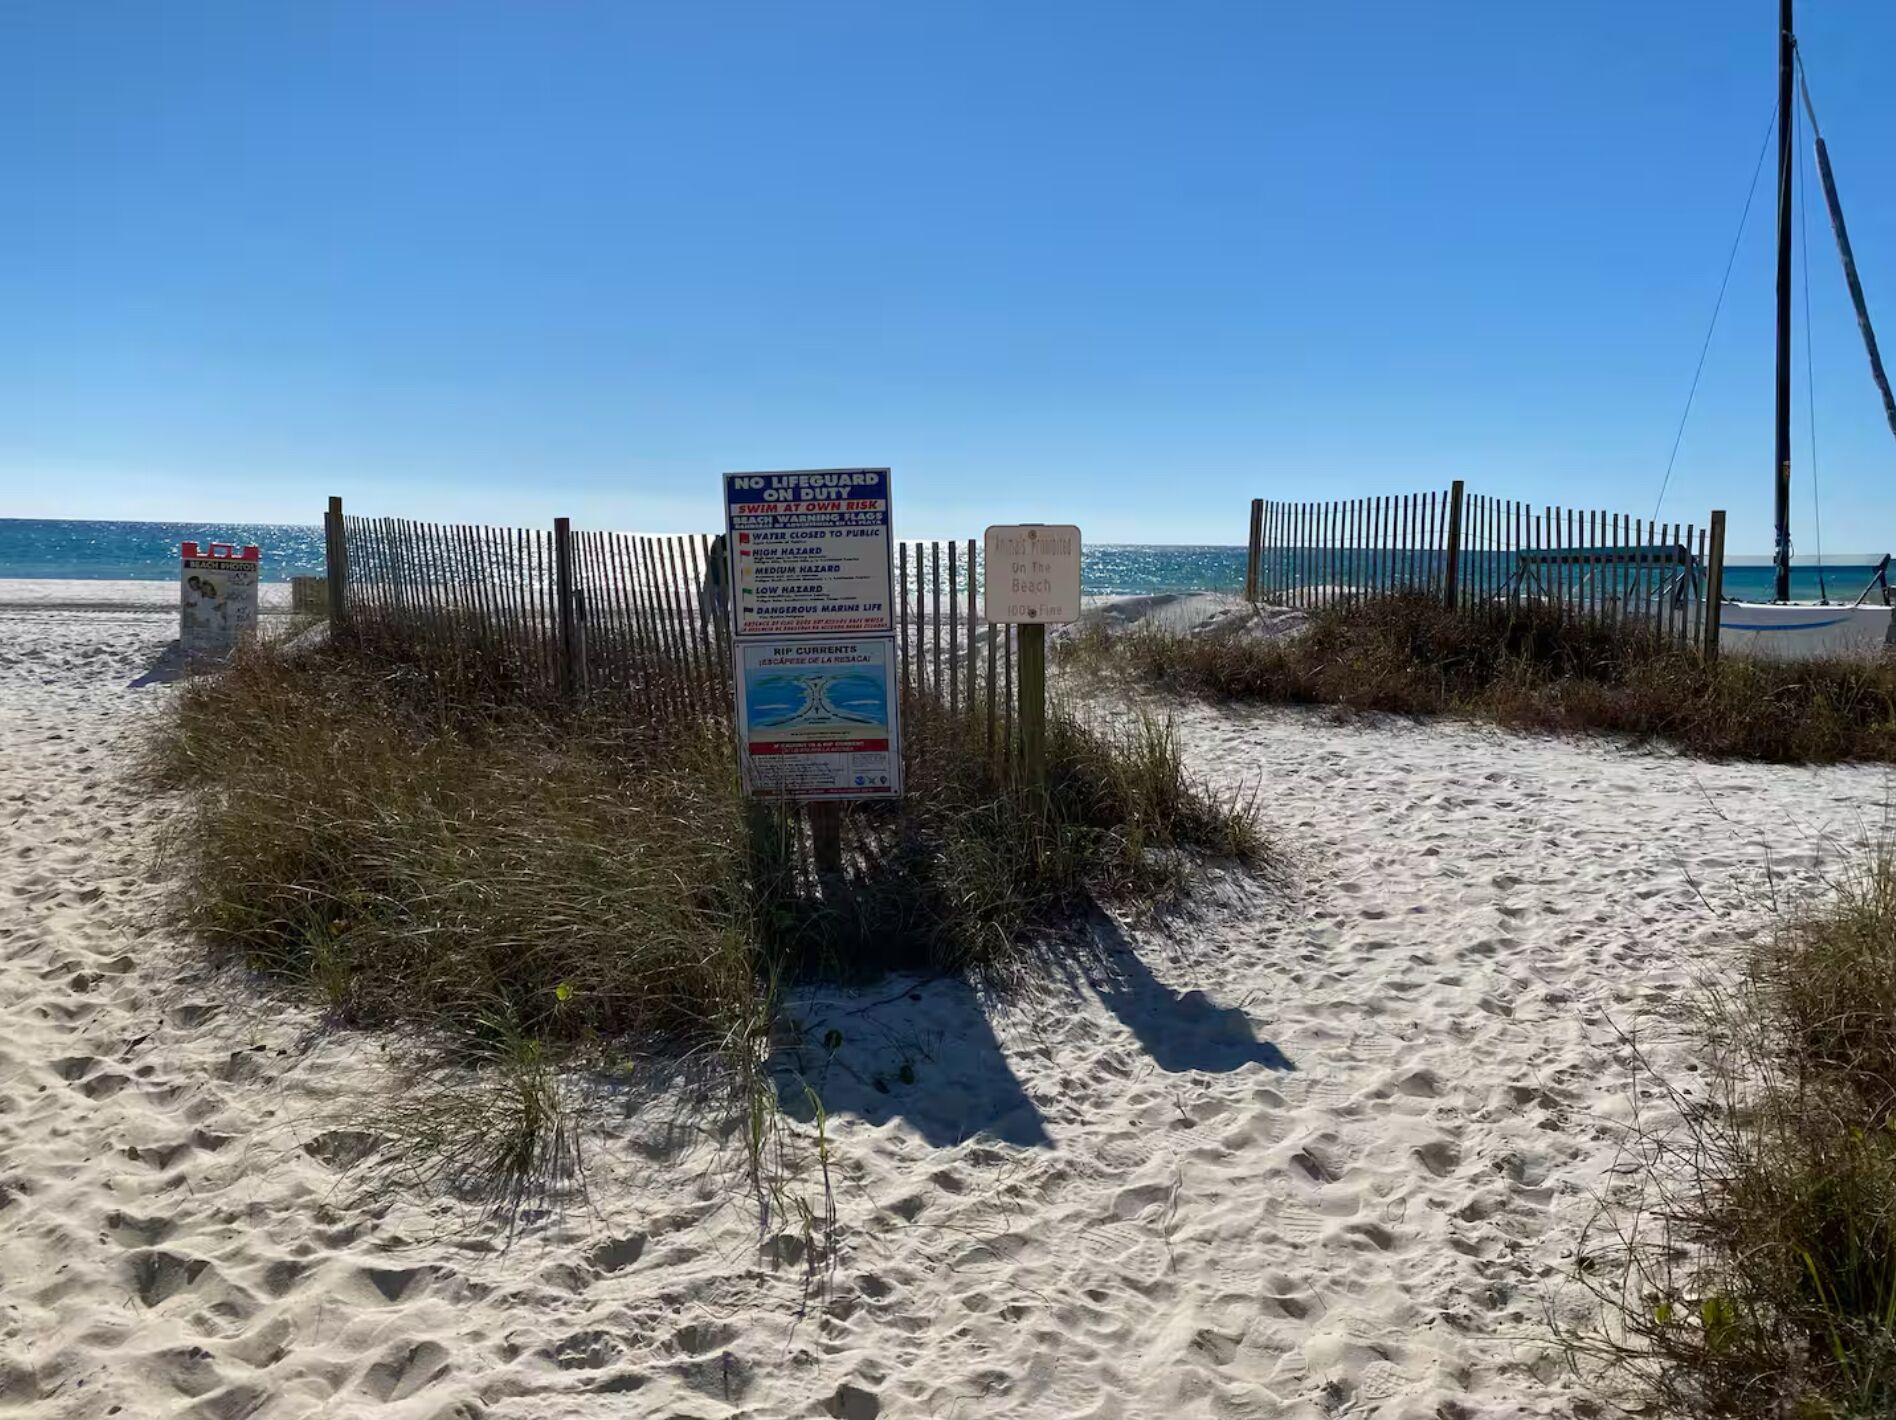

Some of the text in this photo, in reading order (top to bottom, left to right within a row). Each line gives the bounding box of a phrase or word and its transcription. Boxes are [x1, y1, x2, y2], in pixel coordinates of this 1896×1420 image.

[734, 473, 880, 489] NO LIFEGUARD
[763, 486, 851, 501] ON DUTY
[738, 500, 878, 514] SWIM AT OWN RISK
[733, 512, 883, 524] BEACH WARNING FLAGS
[752, 532, 786, 540] WATER
[790, 530, 826, 539] CLOSED
[846, 529, 880, 537] PUBLIC
[752, 547, 822, 557] HIGH HAZARD
[221, 562, 256, 571] PHOTOS
[755, 565, 841, 575] MEDIUM HAZARD
[1032, 562, 1051, 573] The
[756, 585, 823, 594] LOW HAZARD
[1012, 578, 1051, 593] Beach
[757, 603, 883, 614] DANGEROUS MARINE LIFE
[1040, 604, 1063, 616] Fine
[774, 646, 857, 656] RIP CURRENTS
